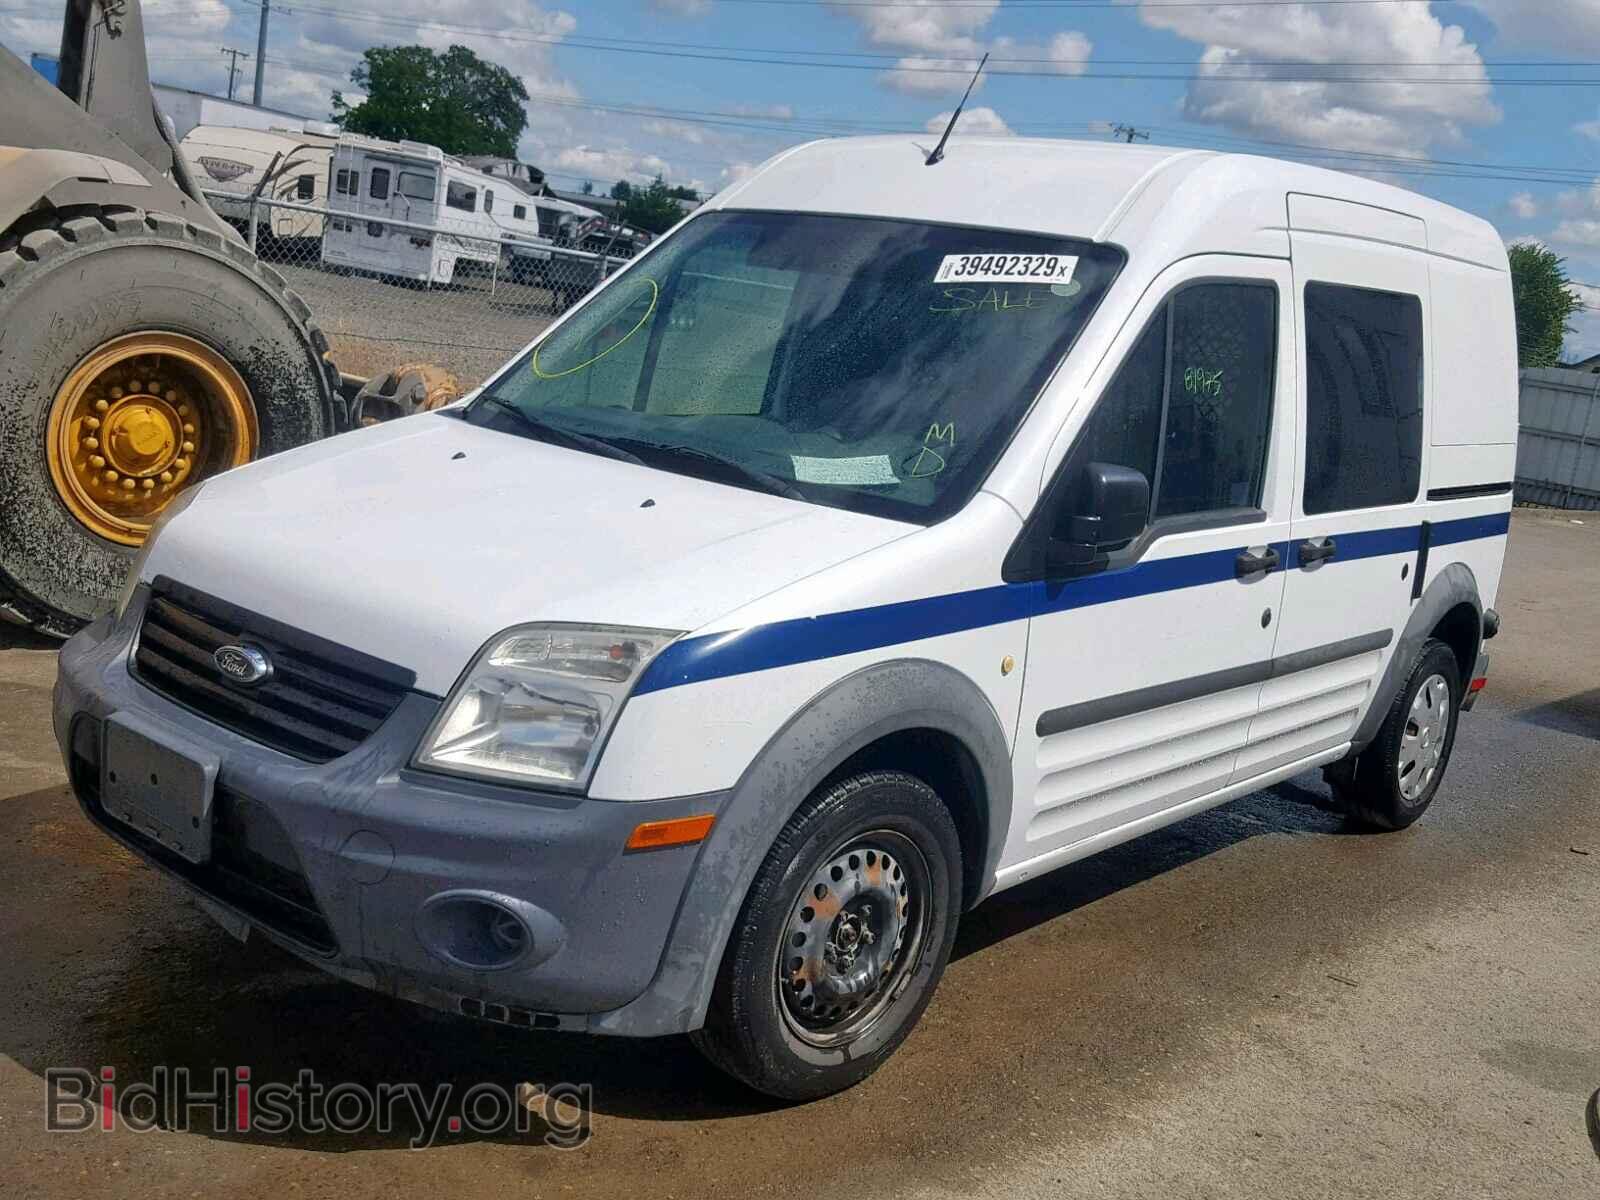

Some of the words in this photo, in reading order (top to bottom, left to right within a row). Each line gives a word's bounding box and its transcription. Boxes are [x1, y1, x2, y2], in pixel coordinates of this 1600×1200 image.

[929, 287, 1050, 312] SALE
[924, 422, 955, 448] M
[221, 652, 248, 674] Ford
